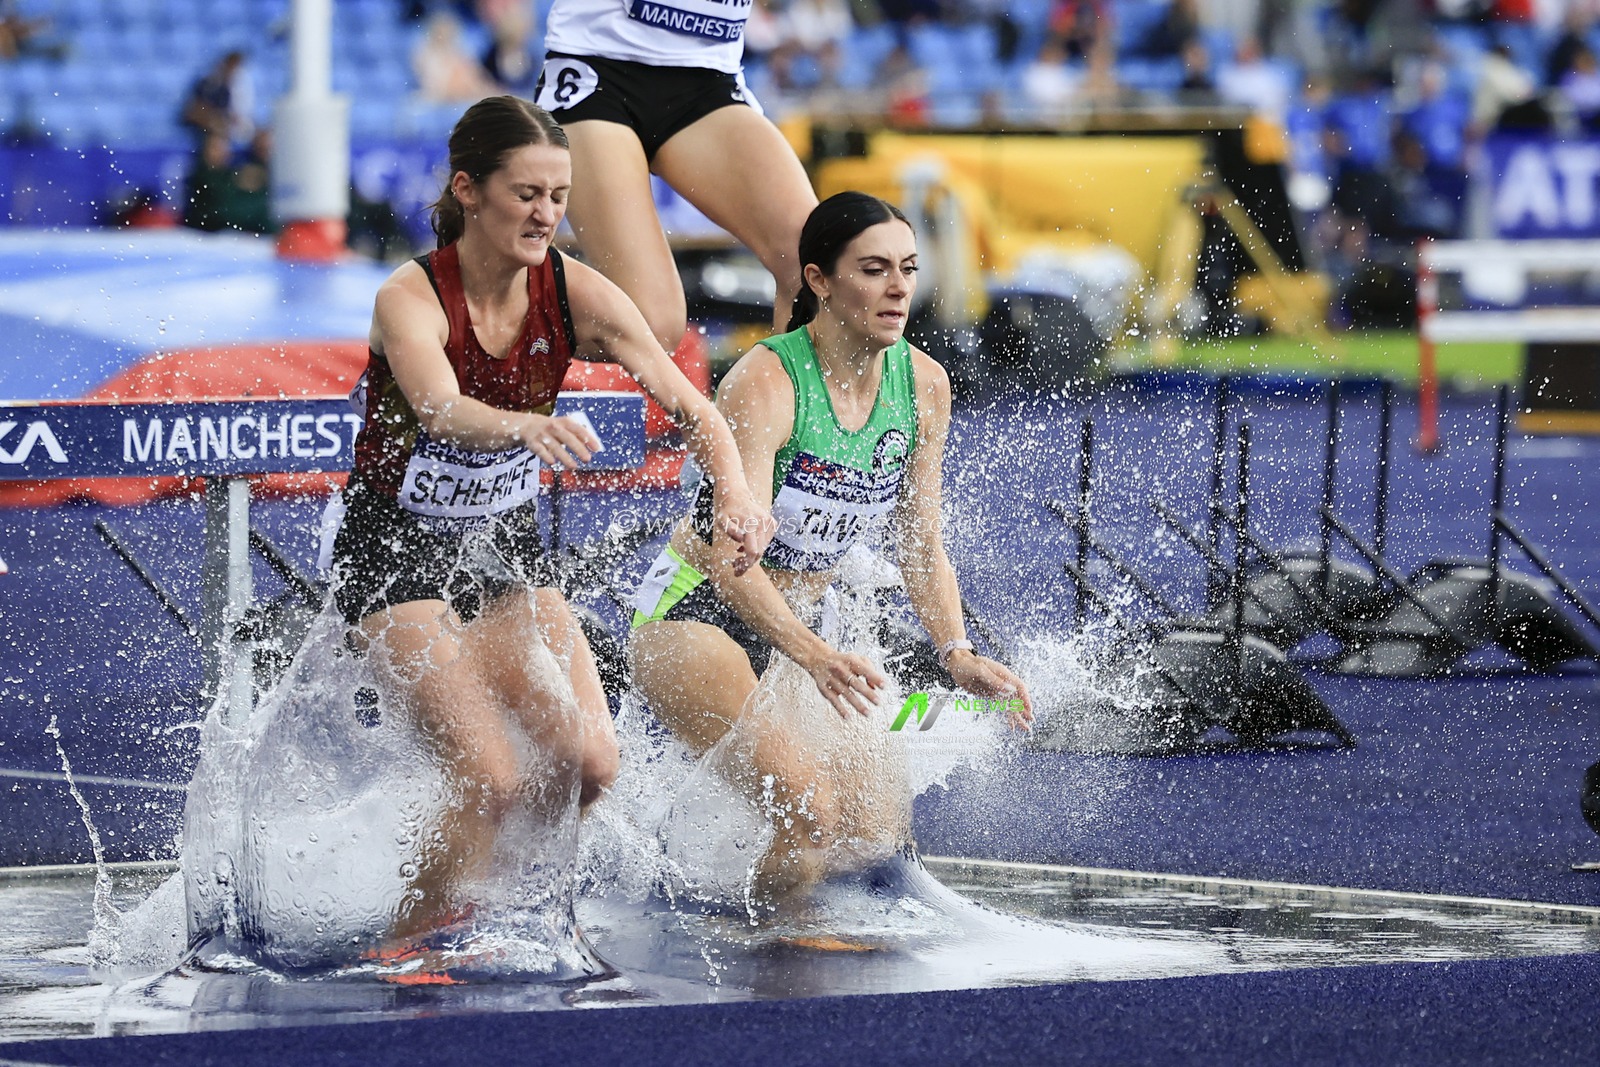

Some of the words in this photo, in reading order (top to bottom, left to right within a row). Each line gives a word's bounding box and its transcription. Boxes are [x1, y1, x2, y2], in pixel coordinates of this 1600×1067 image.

[640, 4, 745, 39] MANCHESTER
[554, 68, 581, 102] 6
[409, 454, 537, 507] SCHERIFF
